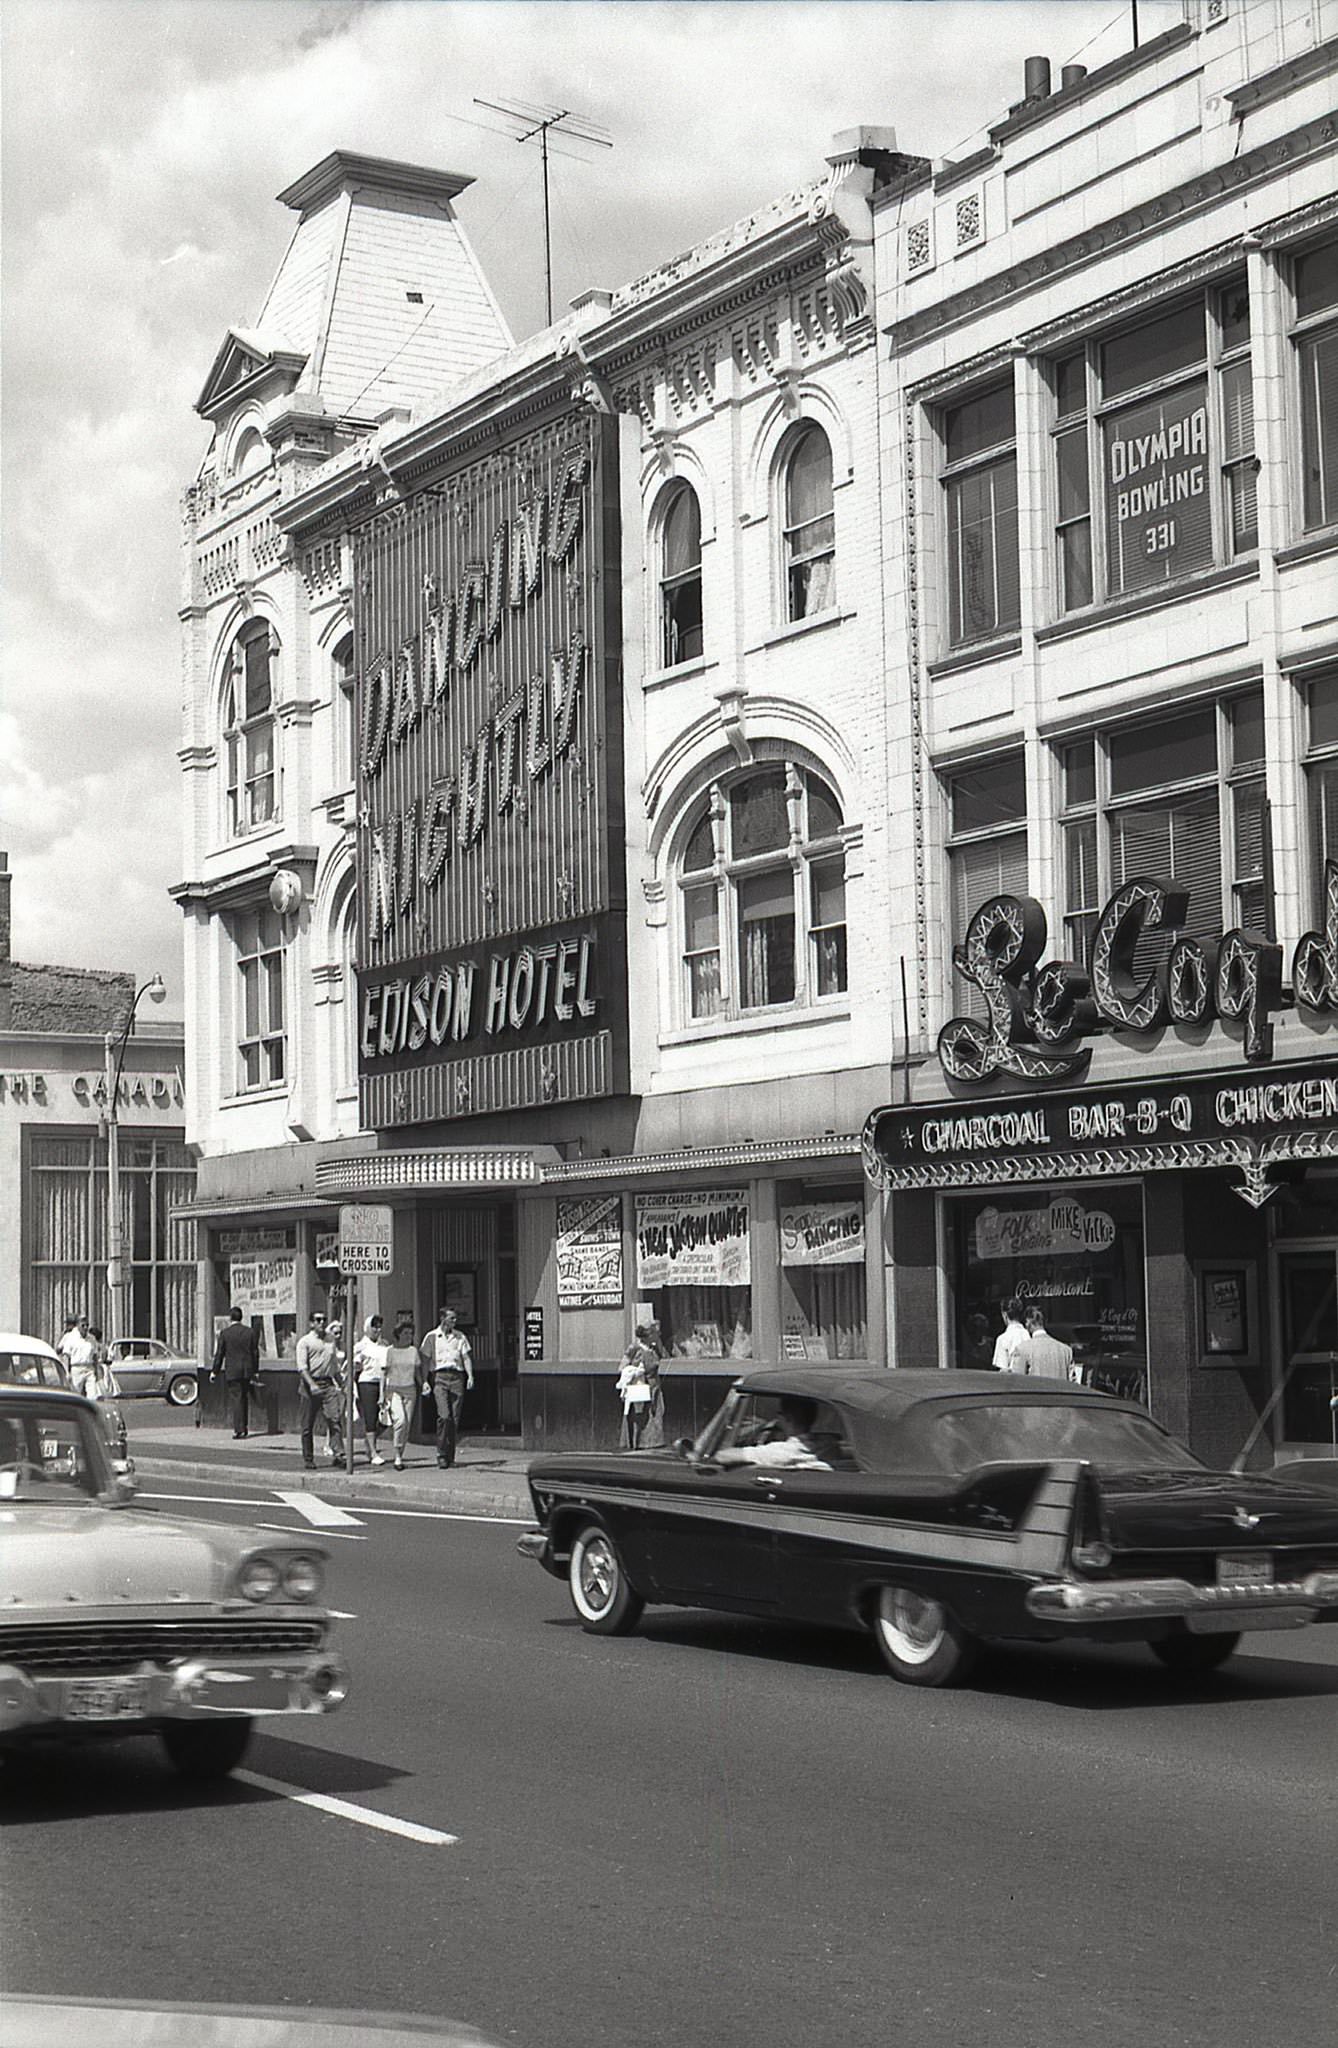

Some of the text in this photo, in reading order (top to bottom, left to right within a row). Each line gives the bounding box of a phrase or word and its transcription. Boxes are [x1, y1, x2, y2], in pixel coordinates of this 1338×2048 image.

[1111, 407, 1207, 485] OLYMPIA
[1118, 464, 1204, 521] BOWLING
[1146, 521, 1175, 553] 331
[359, 442, 588, 780] DANCING
[368, 629, 586, 942] NIGHTLY
[363, 934, 597, 1058] EDISON HOTEL
[921, 1109, 1050, 1153] CHARCOAL
[805, 1214, 860, 1250] DANCING
[1001, 1216, 1033, 1238] FOLK
[341, 1260, 391, 1272] CROSSING
[343, 1246, 389, 1258] HERE TO
[259, 1256, 294, 1285] ROBERTS
[1016, 1276, 1095, 1298] Restaurant
